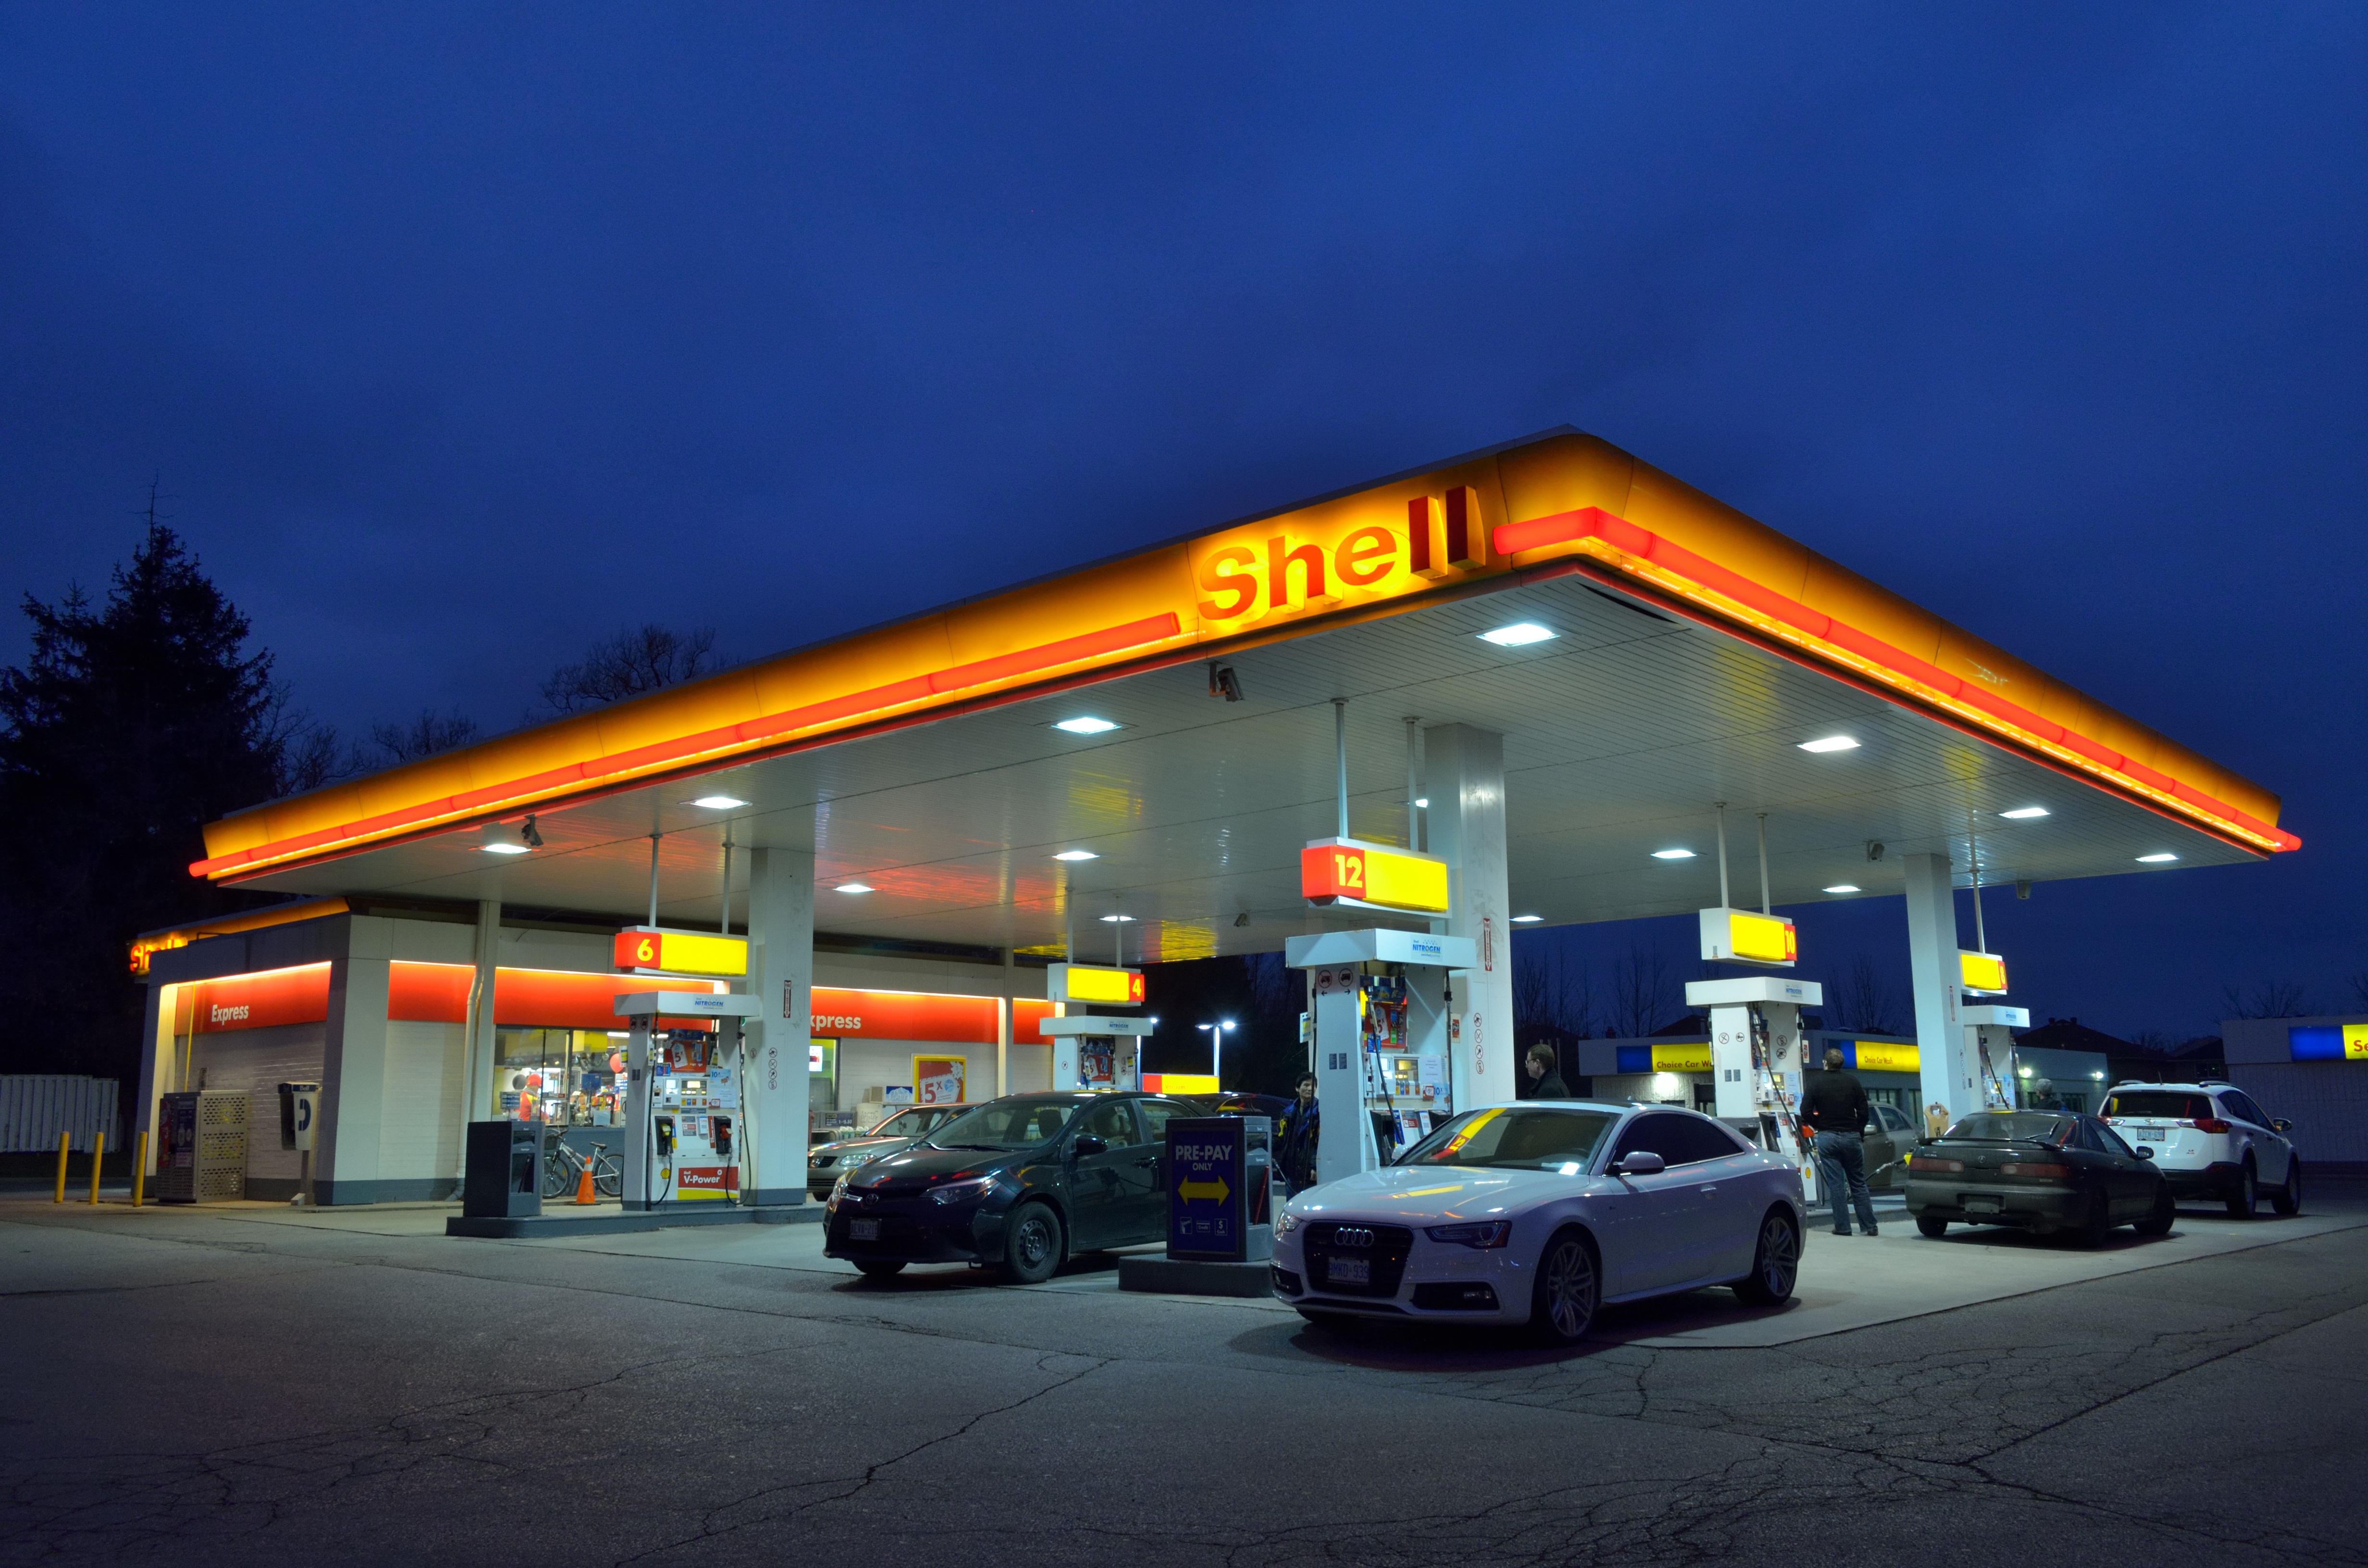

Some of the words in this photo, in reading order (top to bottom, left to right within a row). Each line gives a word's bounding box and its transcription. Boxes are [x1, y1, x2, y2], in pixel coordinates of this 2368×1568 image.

[1199, 486, 1470, 620] Shell
[1335, 855, 1363, 888] 12
[637, 939, 653, 961] 6
[1413, 944, 1441, 952] NITROGEN
[1785, 931, 1795, 954] 10
[2000, 966, 2006, 984] 8
[1133, 978, 1141, 997] 4
[211, 1004, 249, 1026] Express
[811, 1015, 861, 1031] xpress
[1175, 1145, 1233, 1161] PRE-PAY
[1193, 1163, 1212, 1172] ONLY
[684, 1175, 720, 1184] V-Power
